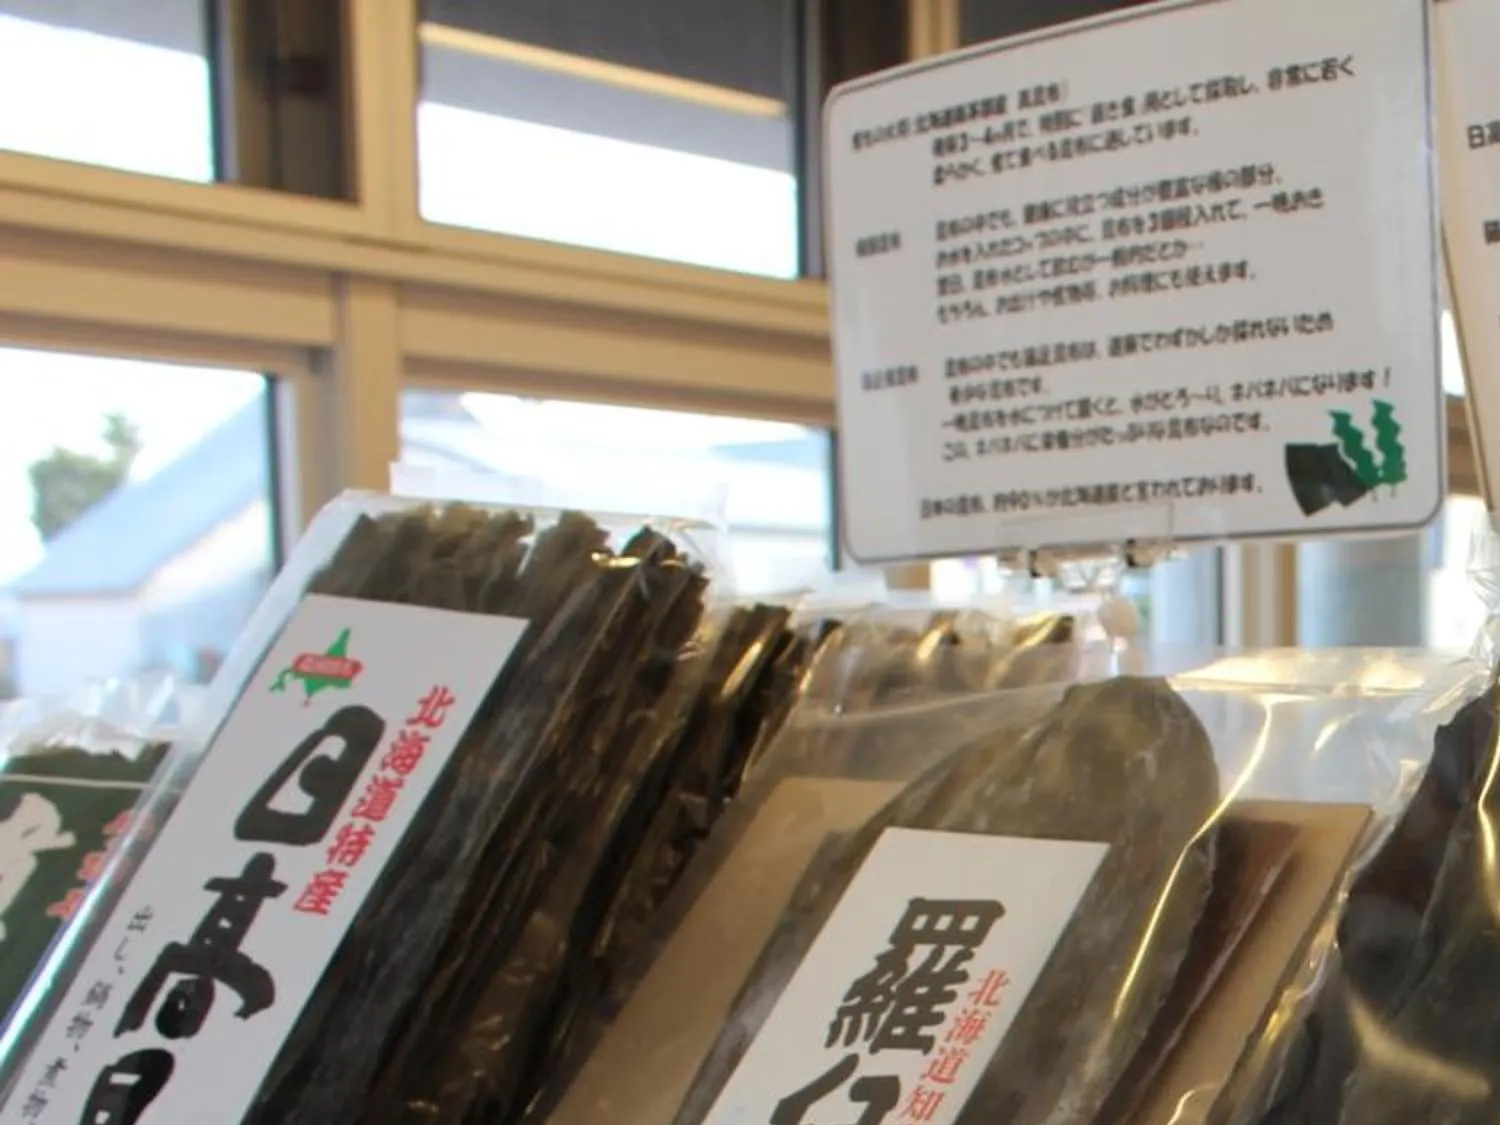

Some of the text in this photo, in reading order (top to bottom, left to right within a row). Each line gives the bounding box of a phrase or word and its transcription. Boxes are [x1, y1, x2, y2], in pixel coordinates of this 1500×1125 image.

[293, 685, 455, 915] 北海道特産
